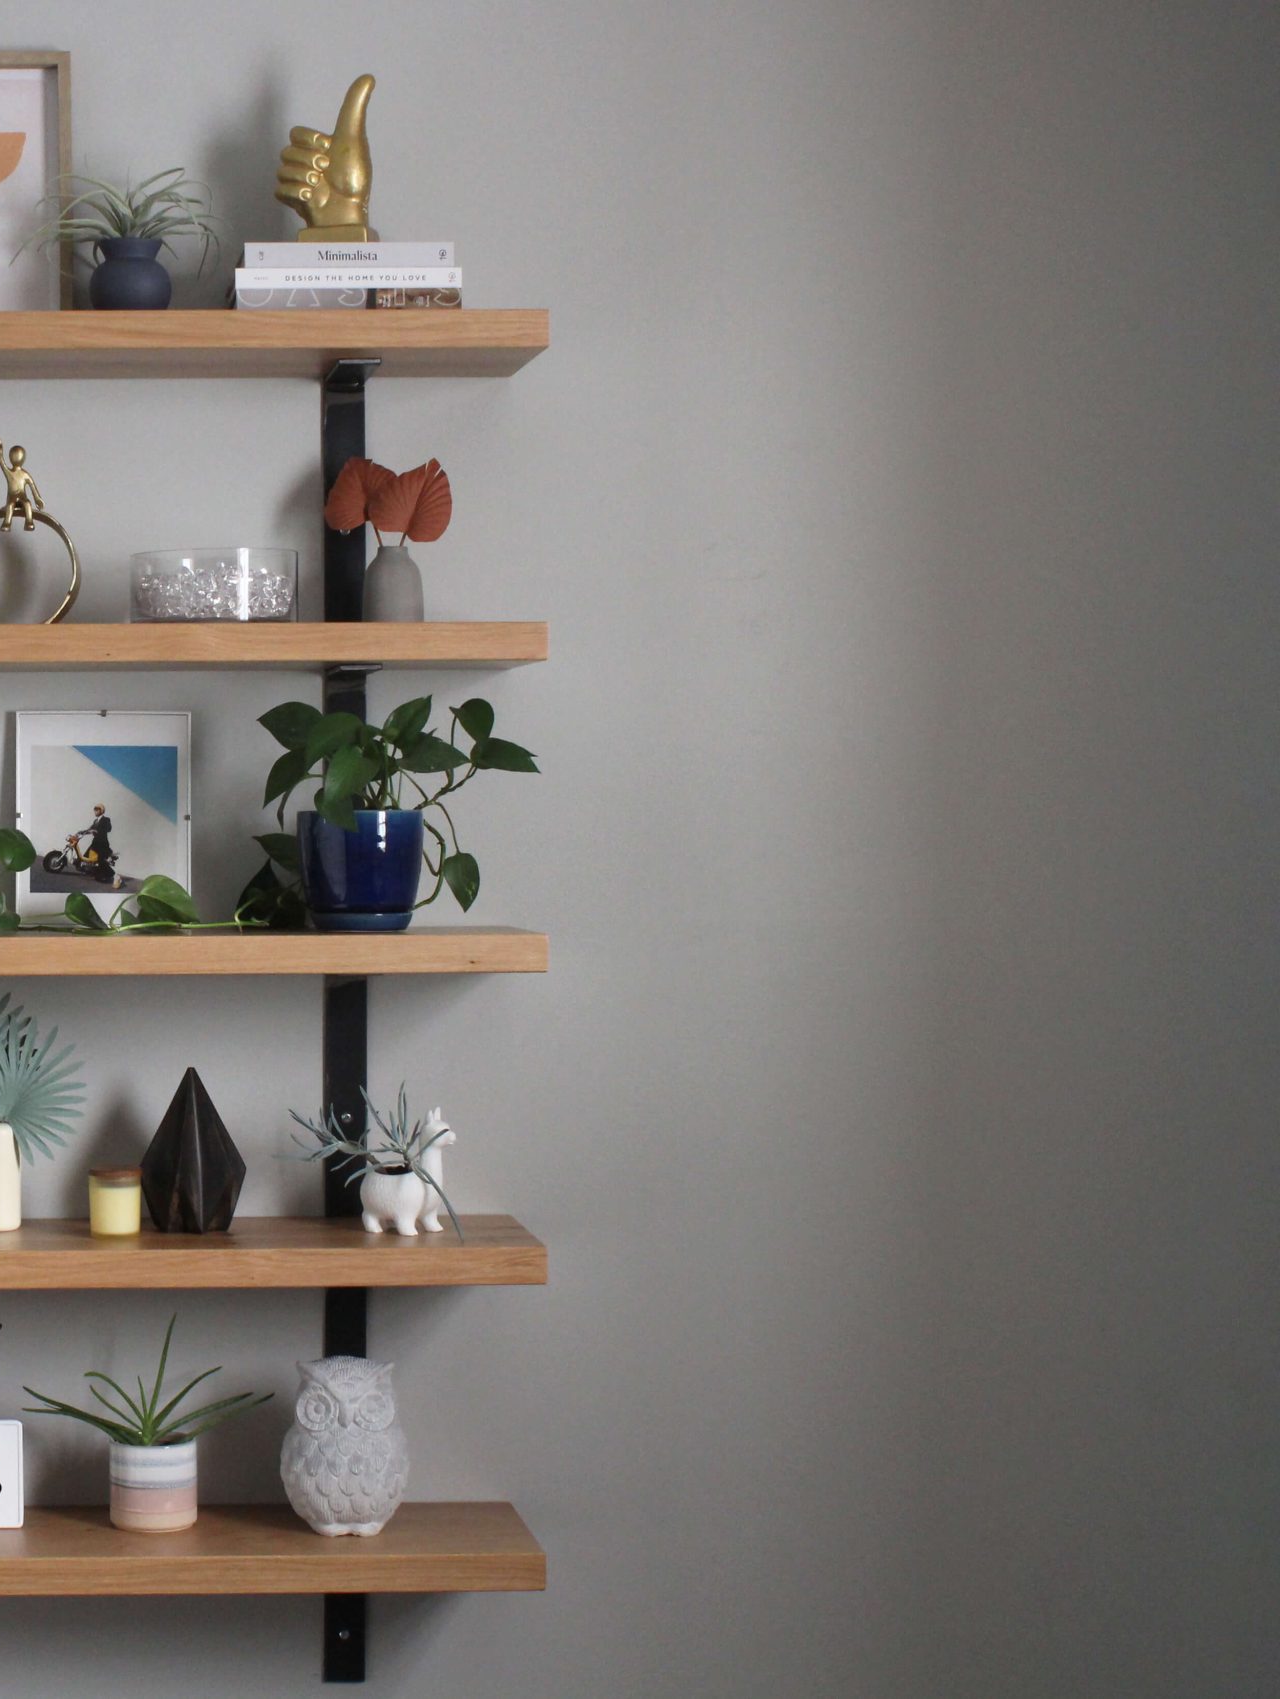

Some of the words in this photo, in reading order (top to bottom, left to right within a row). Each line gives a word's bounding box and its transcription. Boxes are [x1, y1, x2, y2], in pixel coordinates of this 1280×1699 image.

[317, 249, 378, 261] Minimalista
[284, 274, 321, 282] DESIGN
[325, 274, 343, 282] THE
[348, 274, 375, 282] HOME
[379, 274, 398, 282] YOU
[402, 274, 427, 282] LOVE
